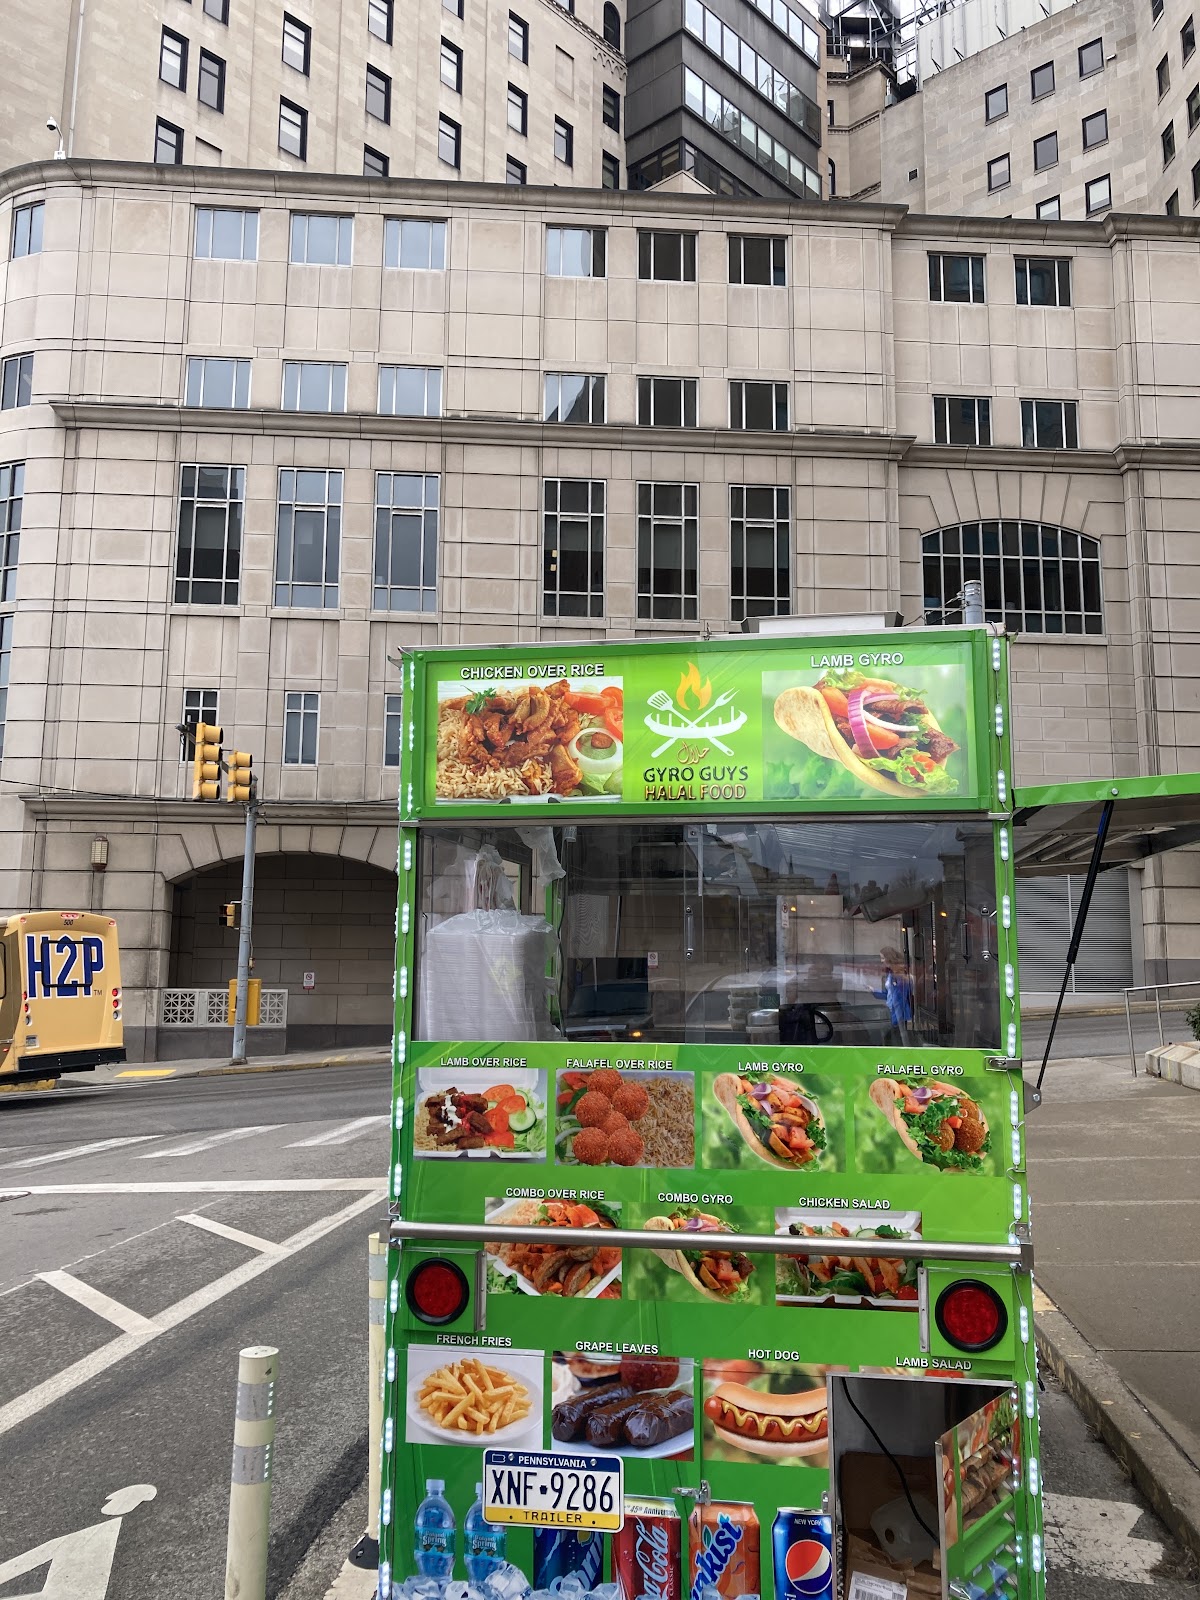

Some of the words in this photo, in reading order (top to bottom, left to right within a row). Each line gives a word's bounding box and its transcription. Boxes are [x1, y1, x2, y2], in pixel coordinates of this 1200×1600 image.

[810, 654, 854, 668] LAMB
[859, 652, 904, 666] GYRO
[460, 666, 523, 679] CHICKEN
[527, 664, 567, 677] OVER
[570, 663, 604, 677] RICE
[643, 766, 694, 782] GYRO
[699, 765, 749, 781] GUYS
[644, 784, 697, 801] HALAL
[700, 783, 746, 800] FOOD
[25, 933, 105, 999] H2P
[440, 1057, 469, 1067] LAMB
[471, 1057, 500, 1067] OVER
[502, 1058, 527, 1068] RICE
[566, 1058, 613, 1069] FALAFEL
[615, 1059, 645, 1069] OVER
[648, 1060, 673, 1070] RICE
[738, 1061, 769, 1072] LAMB
[772, 1062, 804, 1073] GYRO
[877, 1064, 928, 1075] FALAFEL
[930, 1065, 964, 1076] GYRO
[505, 1187, 545, 1198] COMBO
[547, 1189, 577, 1199] OVER
[579, 1190, 605, 1200] RICE
[657, 1192, 699, 1203] COMBO
[701, 1194, 734, 1205] GYRO
[798, 1197, 849, 1208] CHICKEN
[852, 1199, 891, 1210] SALAD
[436, 1334, 479, 1345] FRENCH
[481, 1336, 512, 1347] FRIES
[575, 1340, 613, 1352] GRAPE
[615, 1342, 659, 1354] LEAVES
[748, 1348, 772, 1359] HOT
[774, 1349, 800, 1361] DOG
[896, 1356, 929, 1368] LAMB
[931, 1358, 972, 1370] SALAD
[518, 1455, 587, 1468] PENNSYLVANIA
[523, 1511, 582, 1523] TRAILER
[807, 1518, 823, 1526] YORK
[422, 1536, 447, 1547] Spring
[472, 1539, 497, 1551] Spring
